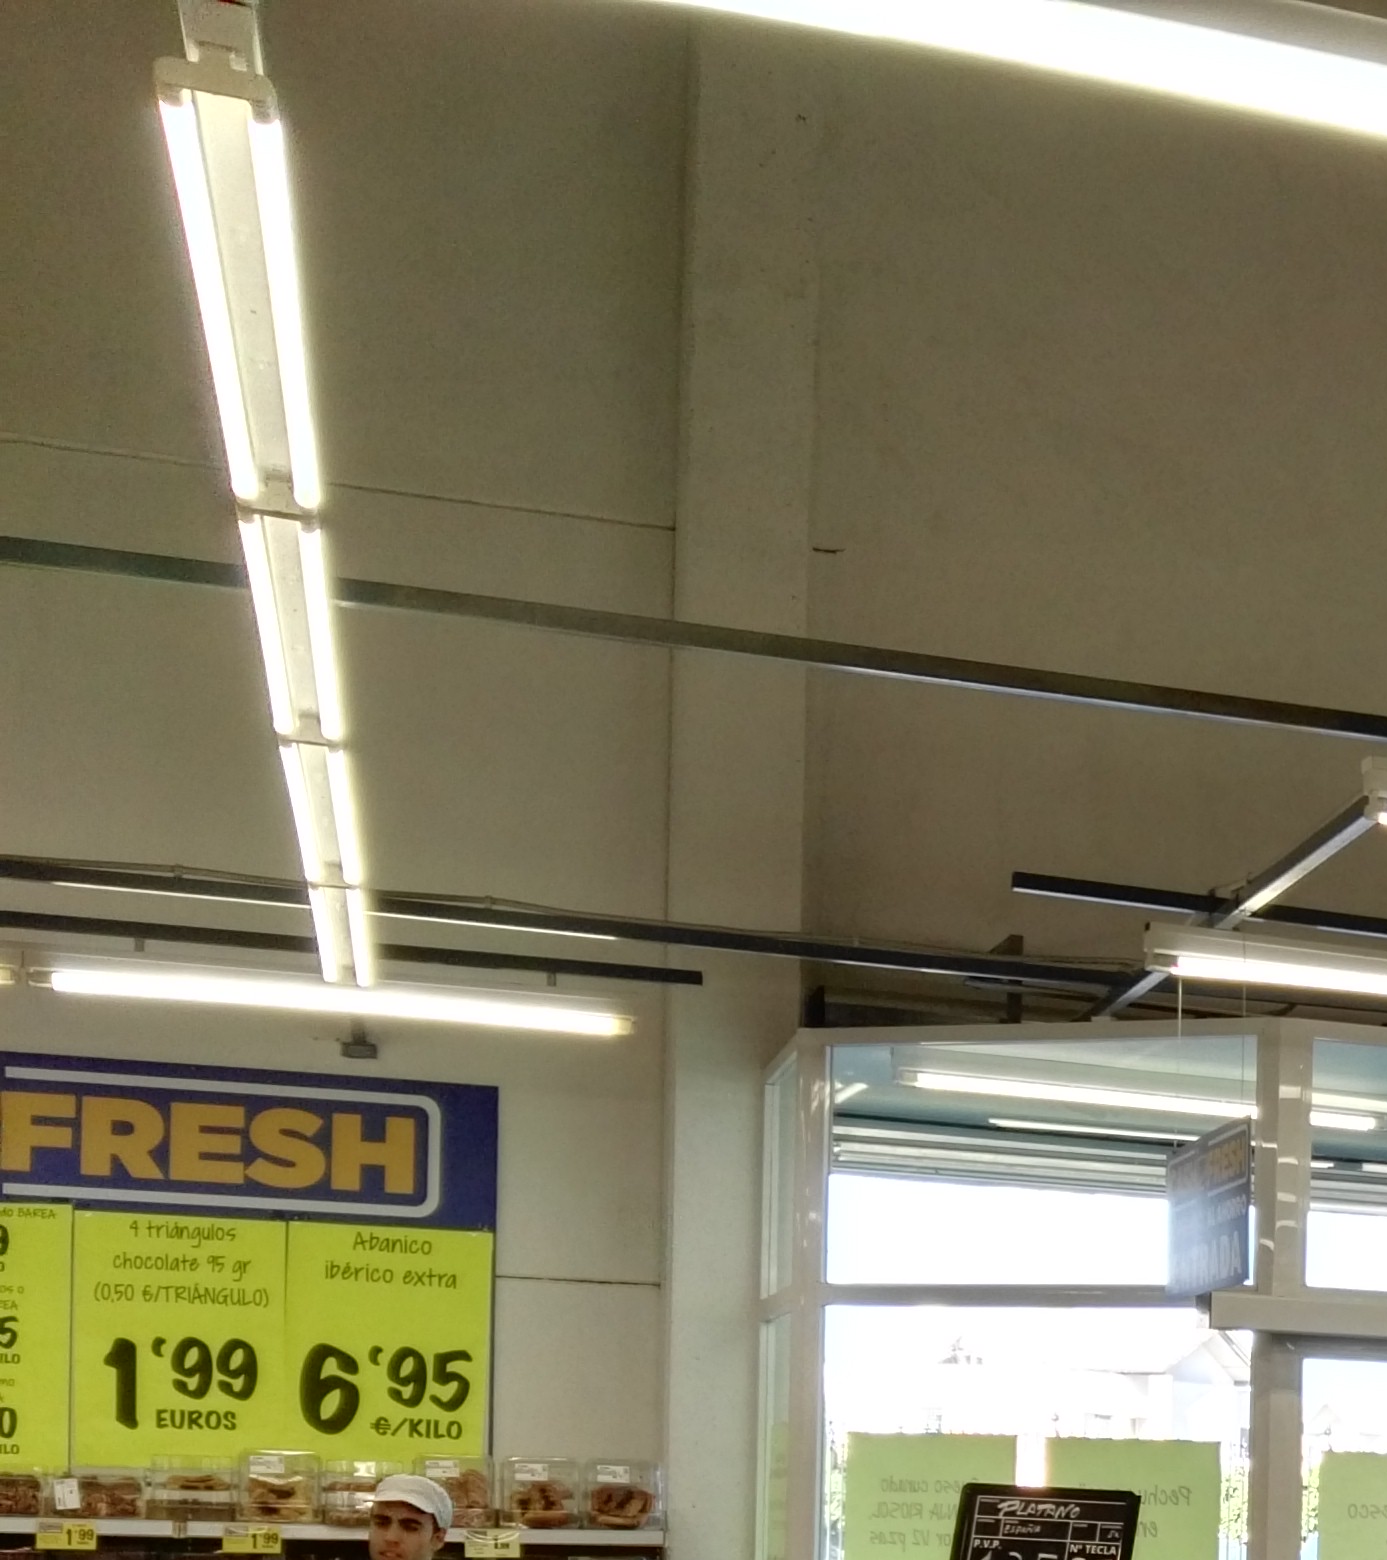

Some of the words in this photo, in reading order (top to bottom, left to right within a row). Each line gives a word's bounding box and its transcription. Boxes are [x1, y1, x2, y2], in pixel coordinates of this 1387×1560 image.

[2, 1090, 415, 1195] FRESH
[129, 1220, 139, 1237] 4
[147, 1220, 237, 1248] triángulos
[352, 1231, 433, 1256] Abanico
[113, 1252, 200, 1273] chocolate
[206, 1256, 226, 1273] 95
[232, 1260, 252, 1282] gr
[325, 1260, 394, 1284] ibérico
[402, 1268, 457, 1289] extra
[155, 1409, 237, 1430] EUROS
[370, 1416, 463, 1440] €/KILO
[997, 1499, 1081, 1519] PLATANO
[1085, 1544, 1118, 1556] TECLA
